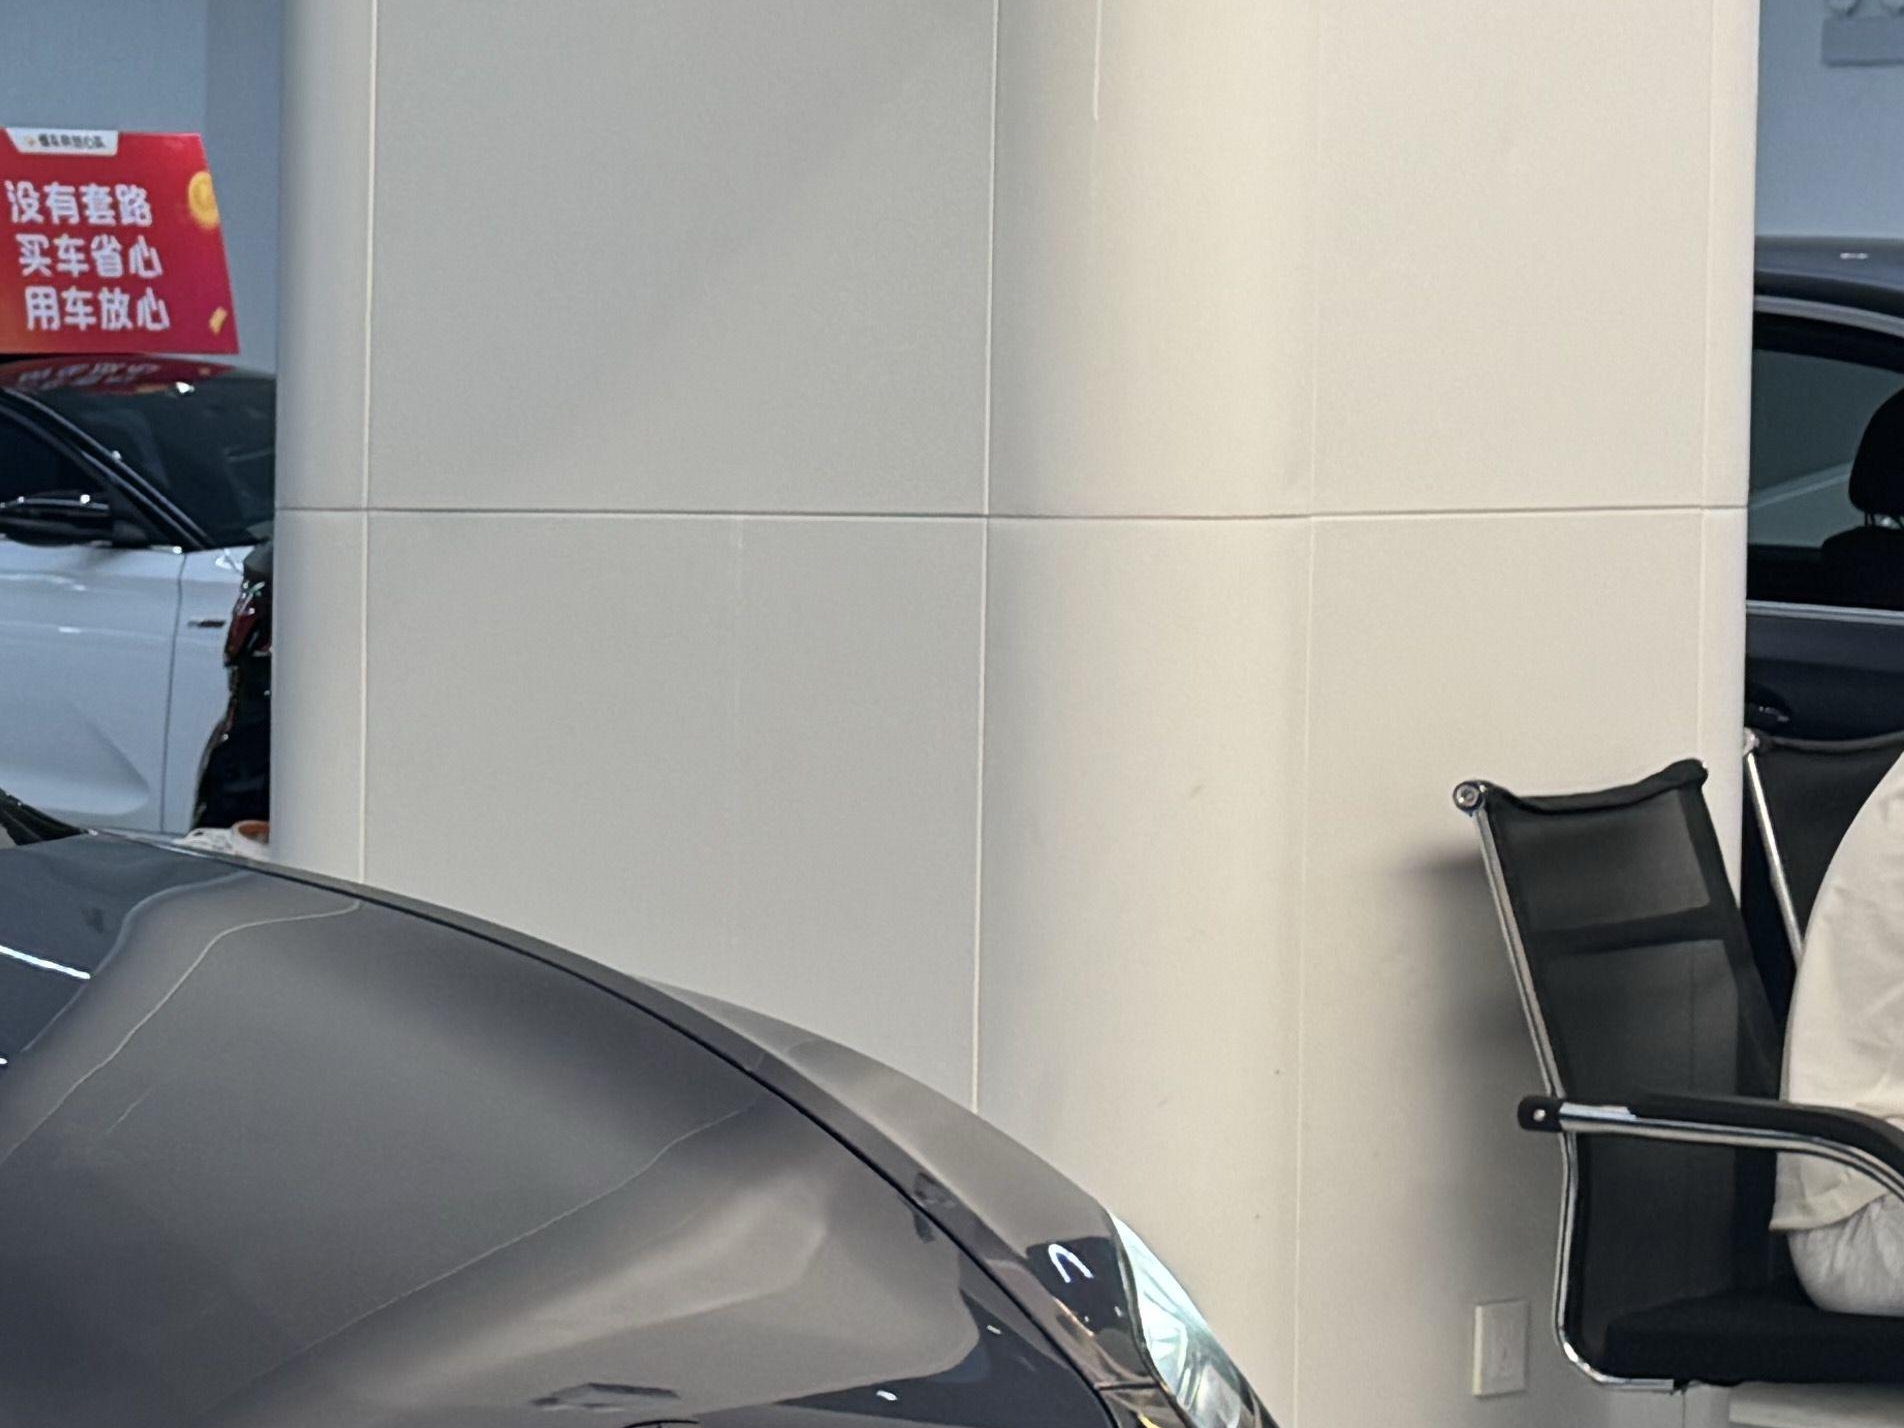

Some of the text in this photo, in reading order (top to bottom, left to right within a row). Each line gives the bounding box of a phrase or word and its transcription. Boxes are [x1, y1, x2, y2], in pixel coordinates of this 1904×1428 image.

[4, 180, 153, 226] 没有套路
[16, 233, 162, 278] 买车省心
[23, 285, 170, 332] 用车放心
